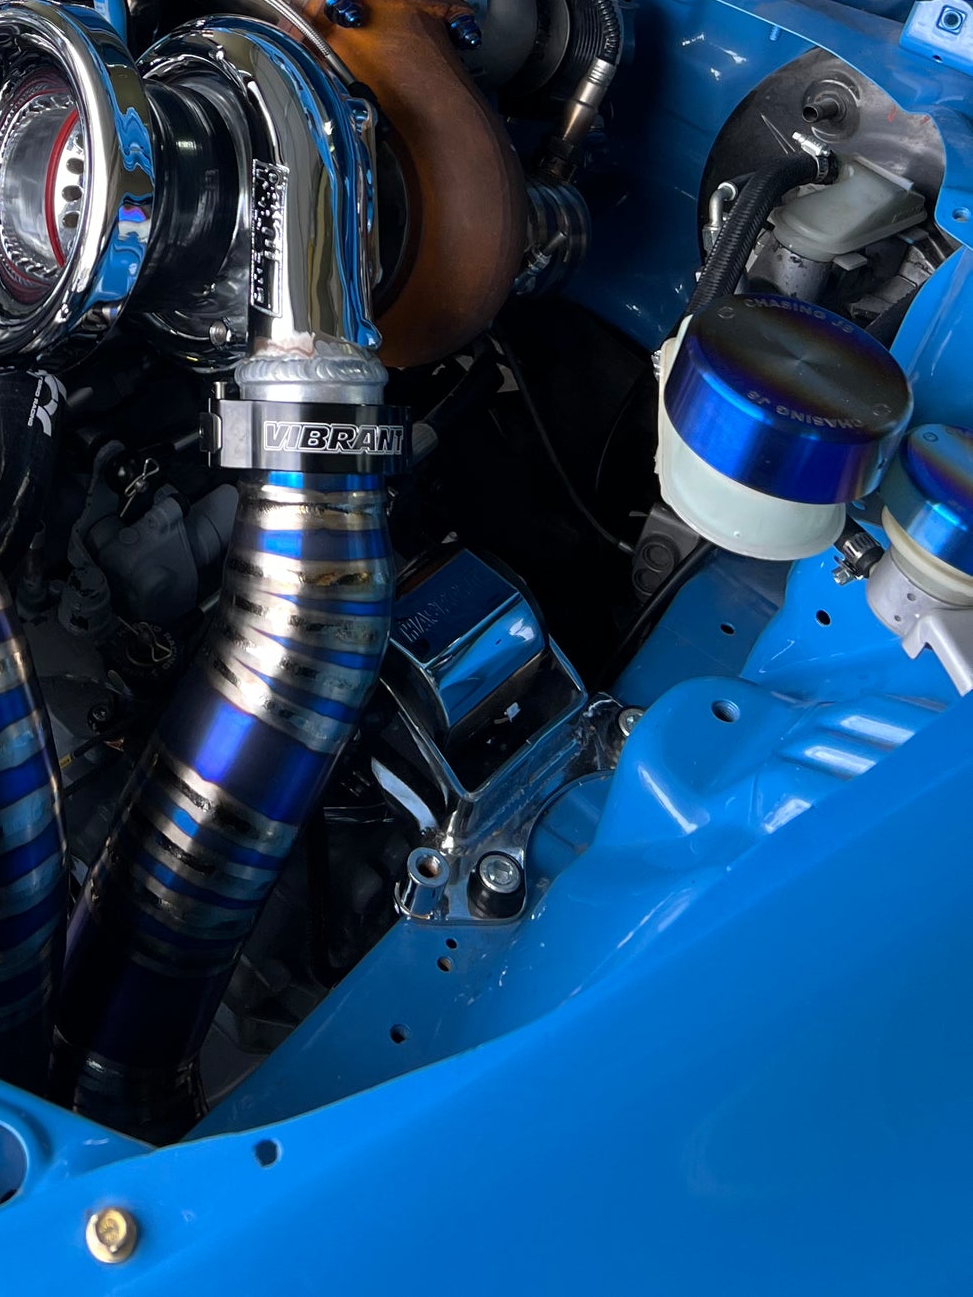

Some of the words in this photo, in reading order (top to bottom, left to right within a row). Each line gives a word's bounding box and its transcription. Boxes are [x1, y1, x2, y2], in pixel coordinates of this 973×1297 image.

[743, 298, 827, 320] CHASING
[831, 320, 855, 334] JS
[745, 390, 772, 405] JS
[776, 404, 865, 429] CHASING
[263, 421, 404, 456] VIBRANT
